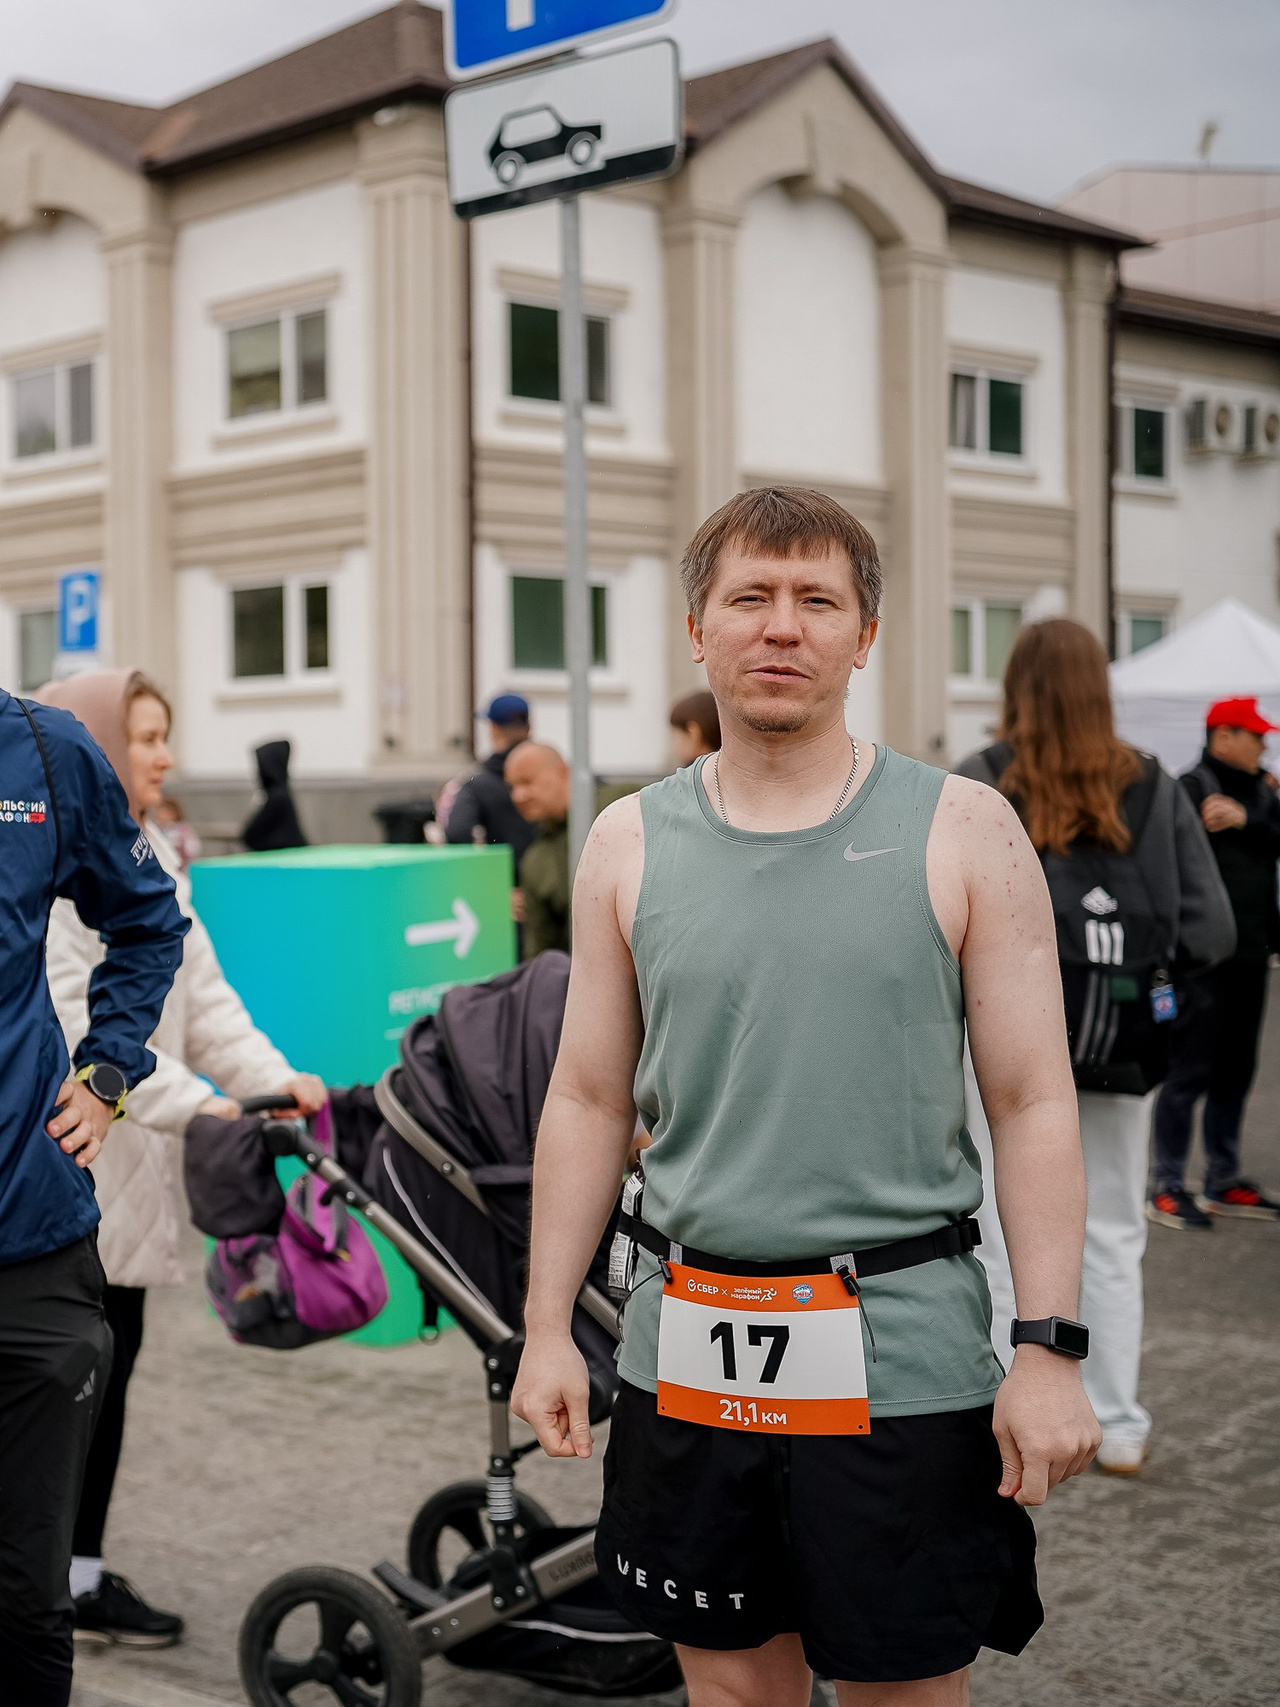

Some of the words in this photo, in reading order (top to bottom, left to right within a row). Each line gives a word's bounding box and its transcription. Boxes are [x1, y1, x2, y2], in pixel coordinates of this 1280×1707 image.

[66, 580, 91, 644] P
[697, 1283, 719, 1295] СБЕР
[730, 1293, 760, 1301] марафон
[710, 1321, 790, 1384] 17
[719, 1399, 758, 1427] 21,1
